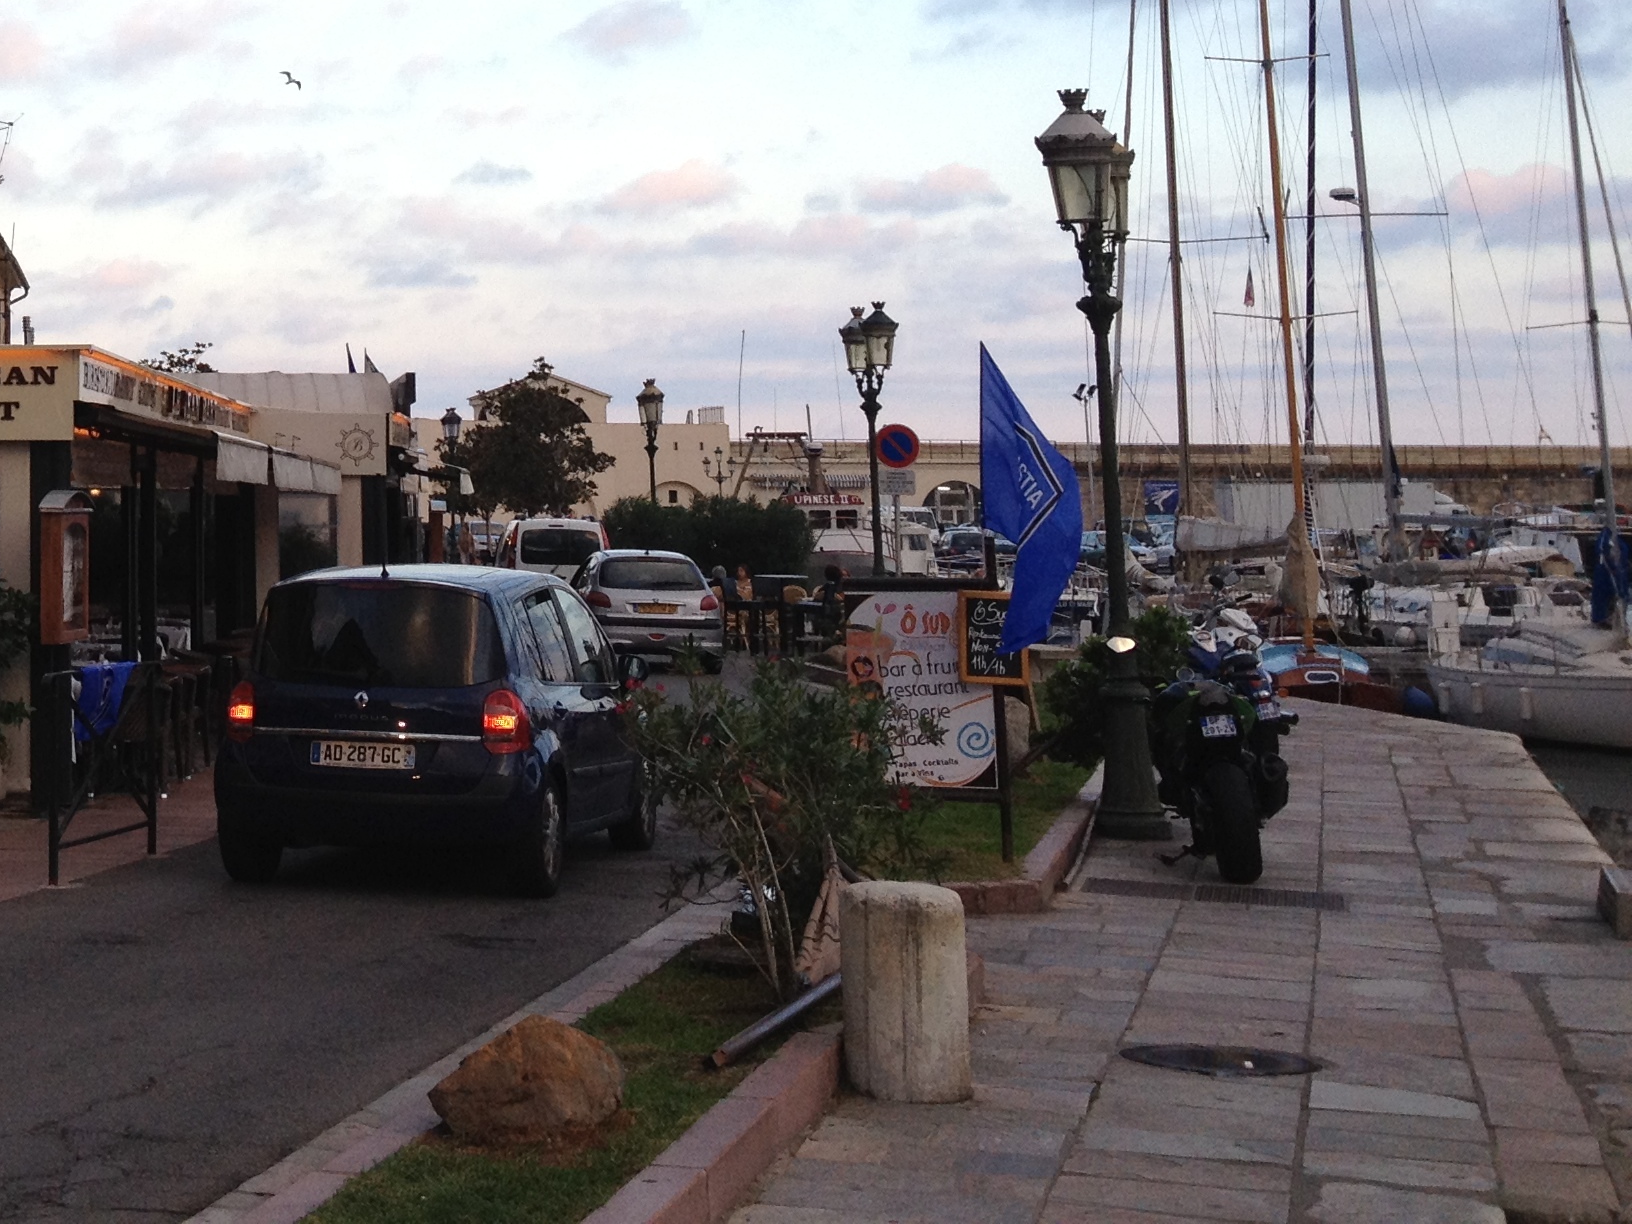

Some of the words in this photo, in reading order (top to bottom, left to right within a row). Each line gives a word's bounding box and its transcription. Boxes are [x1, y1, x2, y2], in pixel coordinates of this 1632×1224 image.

[1017, 456, 1044, 510] STIA
[987, 602, 1008, 622] Su
[878, 654, 906, 677] bar
[888, 681, 970, 697] restaurant
